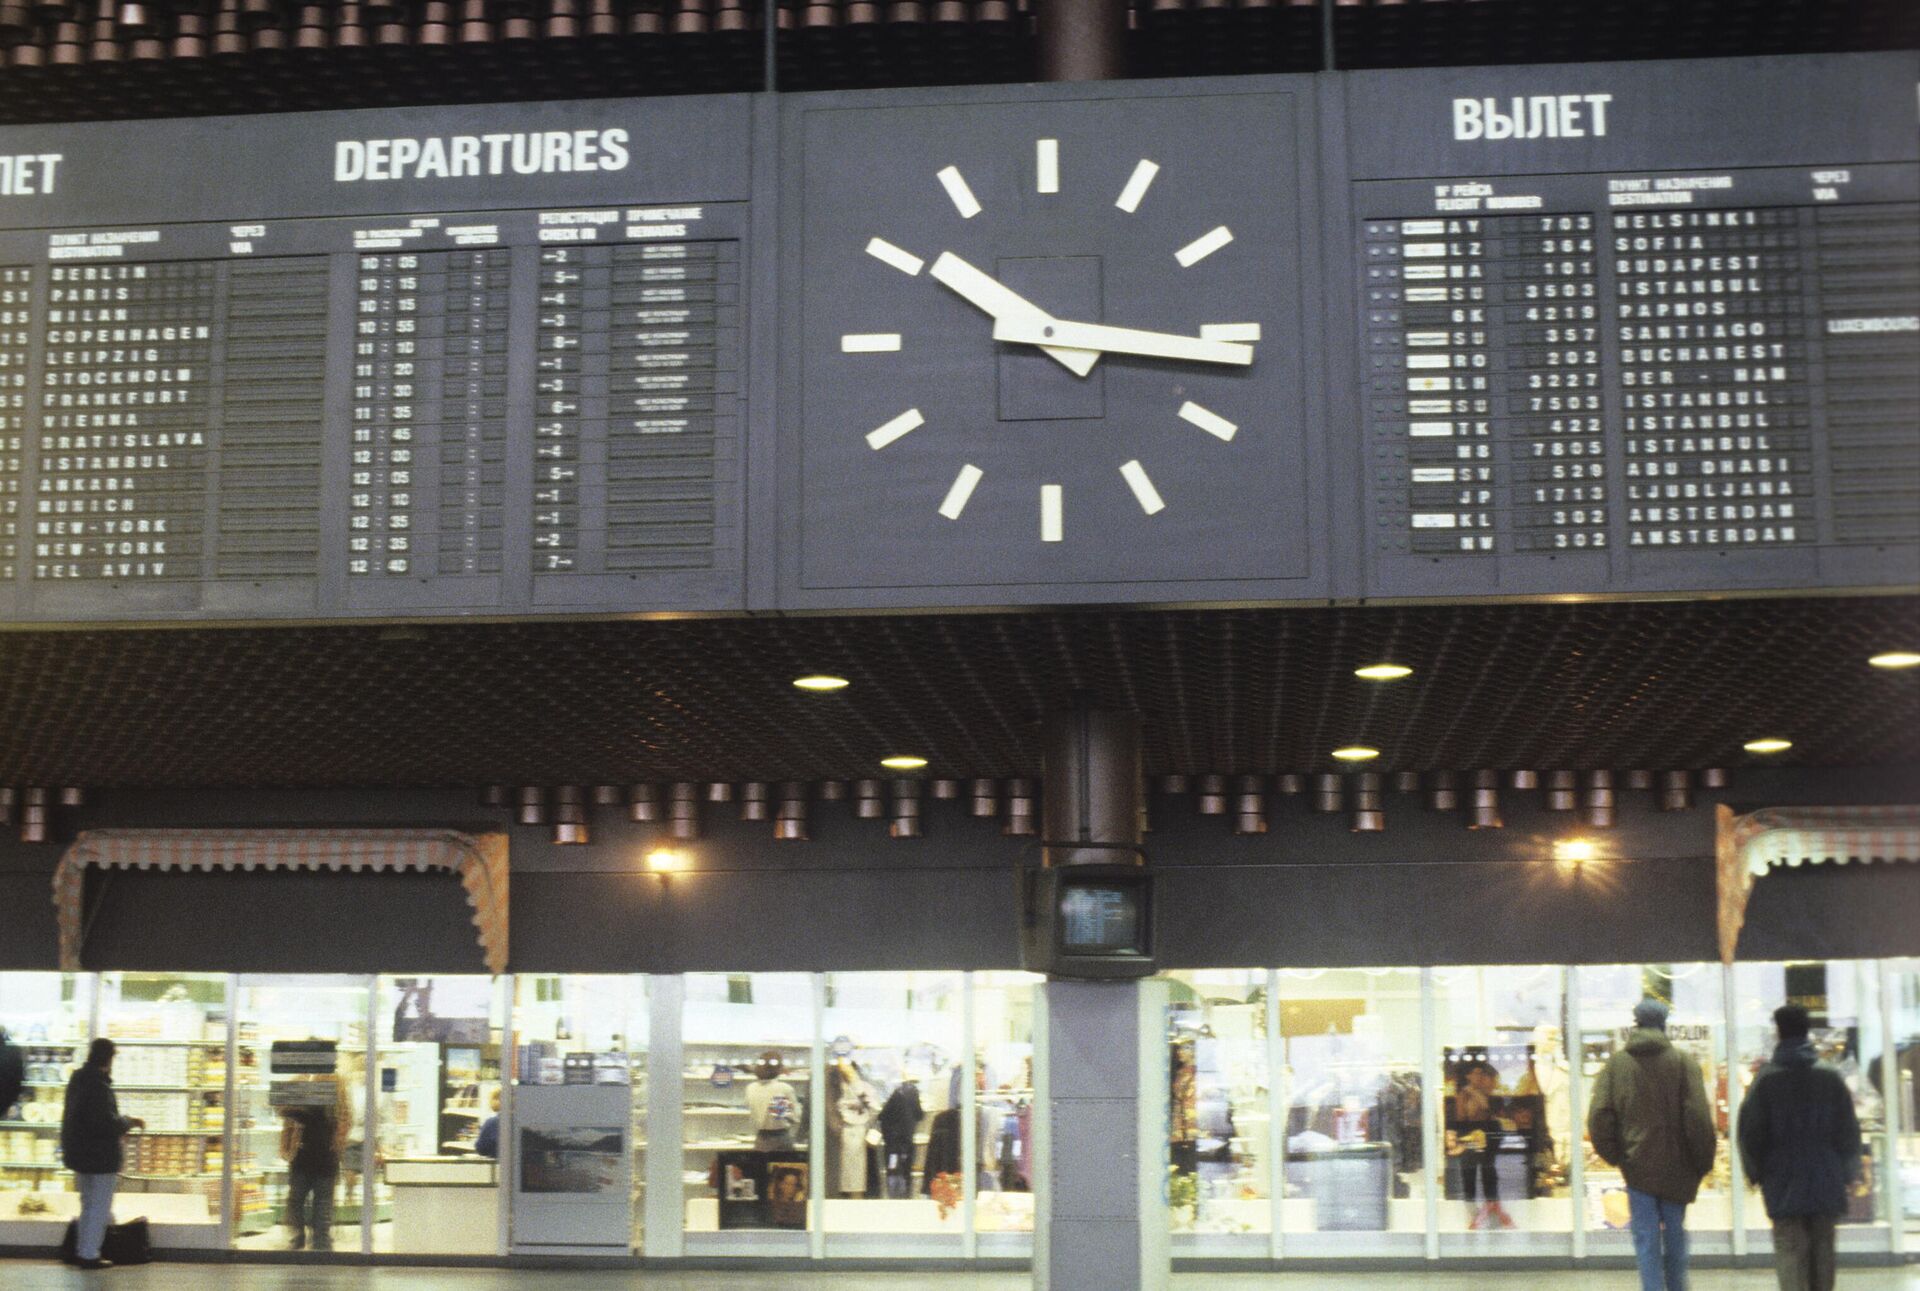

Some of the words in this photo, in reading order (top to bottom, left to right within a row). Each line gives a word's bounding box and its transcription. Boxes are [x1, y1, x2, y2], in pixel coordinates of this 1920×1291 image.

[1452, 93, 1613, 141] ВЫЛЕТ
[334, 127, 630, 182] DEPARTURES
[1609, 190, 1692, 205] DESTINATION
[1448, 220, 1478, 234] AY
[1543, 217, 1589, 230] 703
[1616, 213, 1753, 228] HELSINKI
[1450, 242, 1480, 256] LZ
[1544, 240, 1591, 252] 364
[1617, 237, 1702, 250] SOFIA
[1545, 262, 1589, 274] 101
[1618, 256, 1757, 272] BUDAPEST
[52, 267, 145, 281] BERLIN
[52, 287, 127, 301] PARIS
[1451, 287, 1481, 301] SU
[1527, 284, 1592, 297] 3503
[1621, 279, 1759, 295] ISTANBUL
[49, 309, 126, 322] MILAN
[1527, 306, 1593, 320] 4219
[48, 327, 208, 343] COPENHAGEN
[1453, 331, 1483, 345] SU
[1548, 329, 1594, 342] 357
[1621, 323, 1763, 340] SANTIAGO
[46, 349, 157, 364] LEIPZIG
[1455, 354, 1485, 368] RO
[1549, 351, 1596, 364] 202
[1623, 345, 1782, 362] BUCHAREST
[46, 369, 190, 385] STOCKHOLM
[1455, 376, 1485, 390] LH
[1531, 374, 1596, 387] 3227
[1624, 371, 1672, 384] BER
[44, 390, 187, 406] FRANKFURT
[1455, 399, 1485, 413] SU
[1532, 396, 1597, 410] 7503
[1627, 392, 1766, 407] ISTANBUL
[44, 413, 137, 427] VIENNA
[1457, 421, 1487, 435] TK
[1552, 419, 1599, 432] 422
[1628, 414, 1767, 430] ISTANBUL
[41, 433, 203, 449] BRATISLAVA
[1534, 442, 1600, 455] 7805
[1630, 437, 1768, 452] ISTANBUL
[43, 455, 168, 470] ISTANBUL
[1554, 464, 1601, 478] 529
[1628, 463, 1676, 476] ABU
[1703, 459, 1787, 474] DHABI
[40, 478, 134, 491] ANKARA
[1459, 490, 1489, 504] JP
[1537, 487, 1602, 501] 1713
[1630, 482, 1790, 498] LJUBLJANA
[1459, 513, 1489, 527] KL
[1556, 510, 1602, 523] 302
[1631, 504, 1792, 521] AMSTERDAM
[37, 520, 166, 534] NEW-YORK
[1557, 533, 1603, 547] 302
[1632, 528, 1794, 544] AMSTERDAM
[37, 542, 165, 556] NEW-YORK
[37, 565, 80, 578] TEL
[102, 563, 164, 576] AVIV
